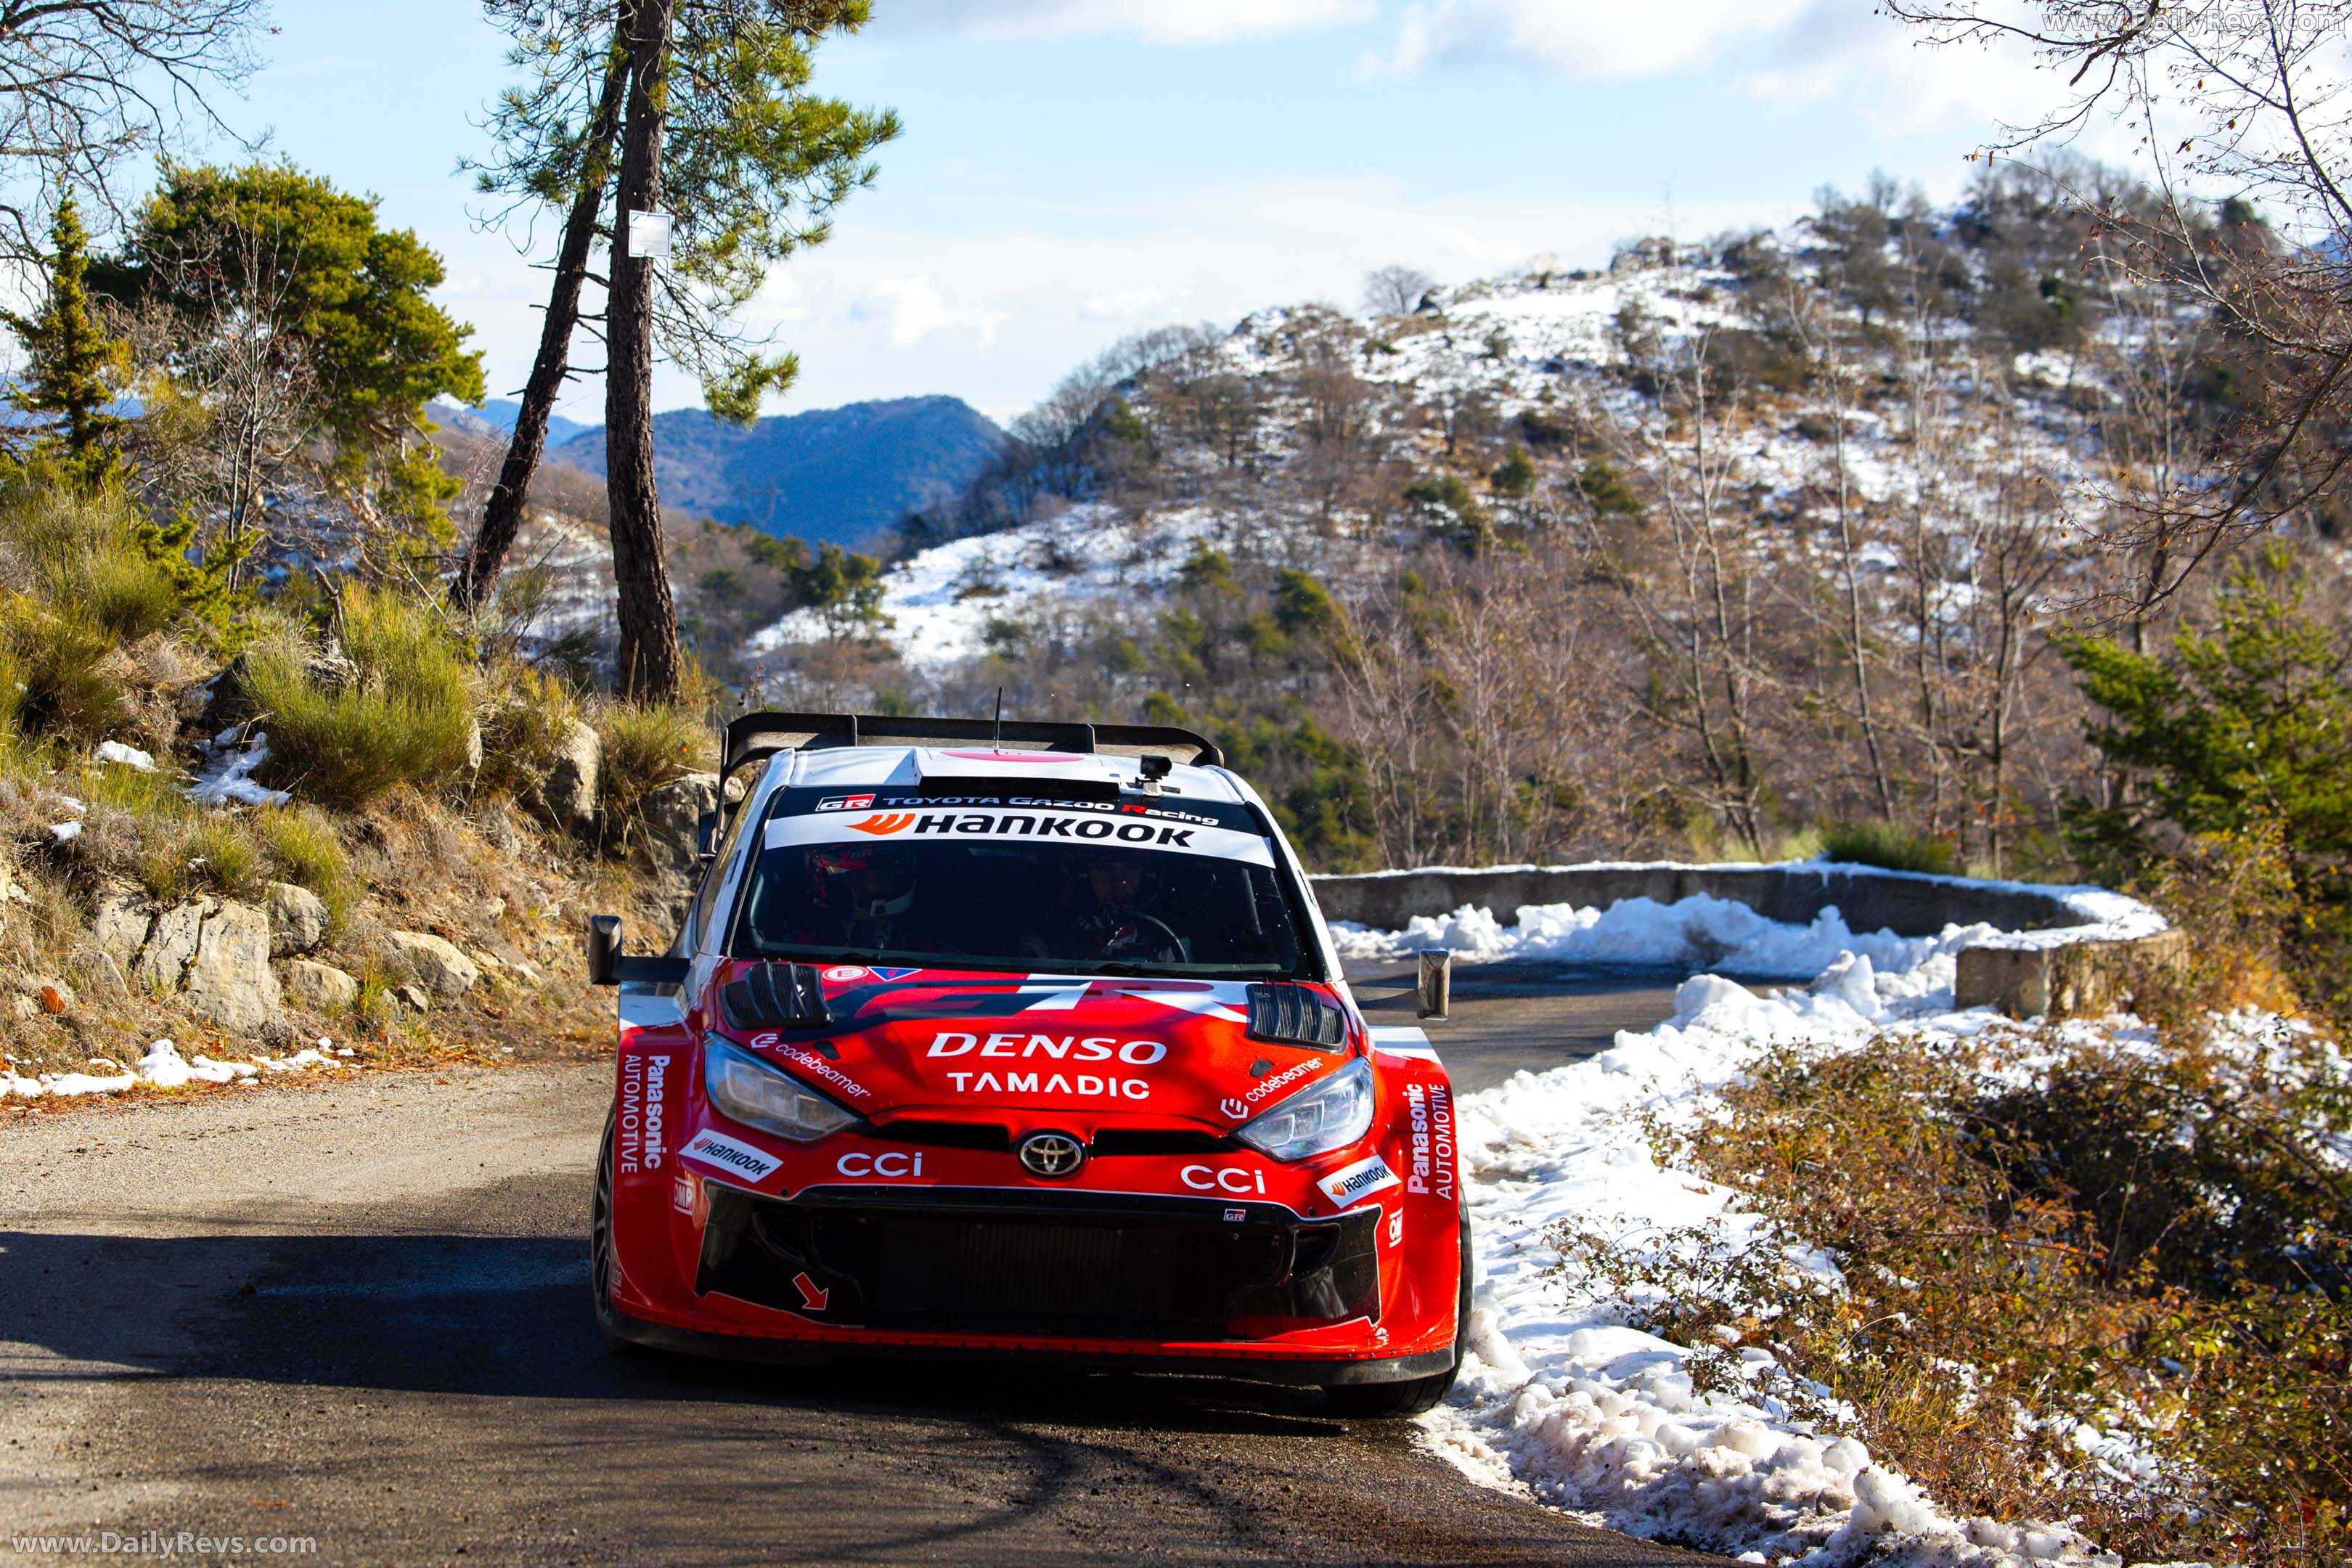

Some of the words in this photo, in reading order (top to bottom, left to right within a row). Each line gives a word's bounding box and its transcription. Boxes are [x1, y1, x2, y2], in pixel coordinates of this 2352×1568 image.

[820, 799, 870, 809] GR
[1009, 797, 1115, 810] GAZOO
[1122, 804, 1220, 826] Racing
[775, 1042, 870, 1098] codebeamer
[926, 1033, 1167, 1065] DENSO
[947, 1072, 1150, 1100] TAMADIC
[1246, 1057, 1321, 1102] codebeamer
[621, 1055, 641, 1174] AUTOMOTIVE
[645, 1055, 670, 1169] Panasonic
[1402, 1083, 1429, 1194] Panasonic
[1428, 1084, 1452, 1200] AUTOMOTIVE
